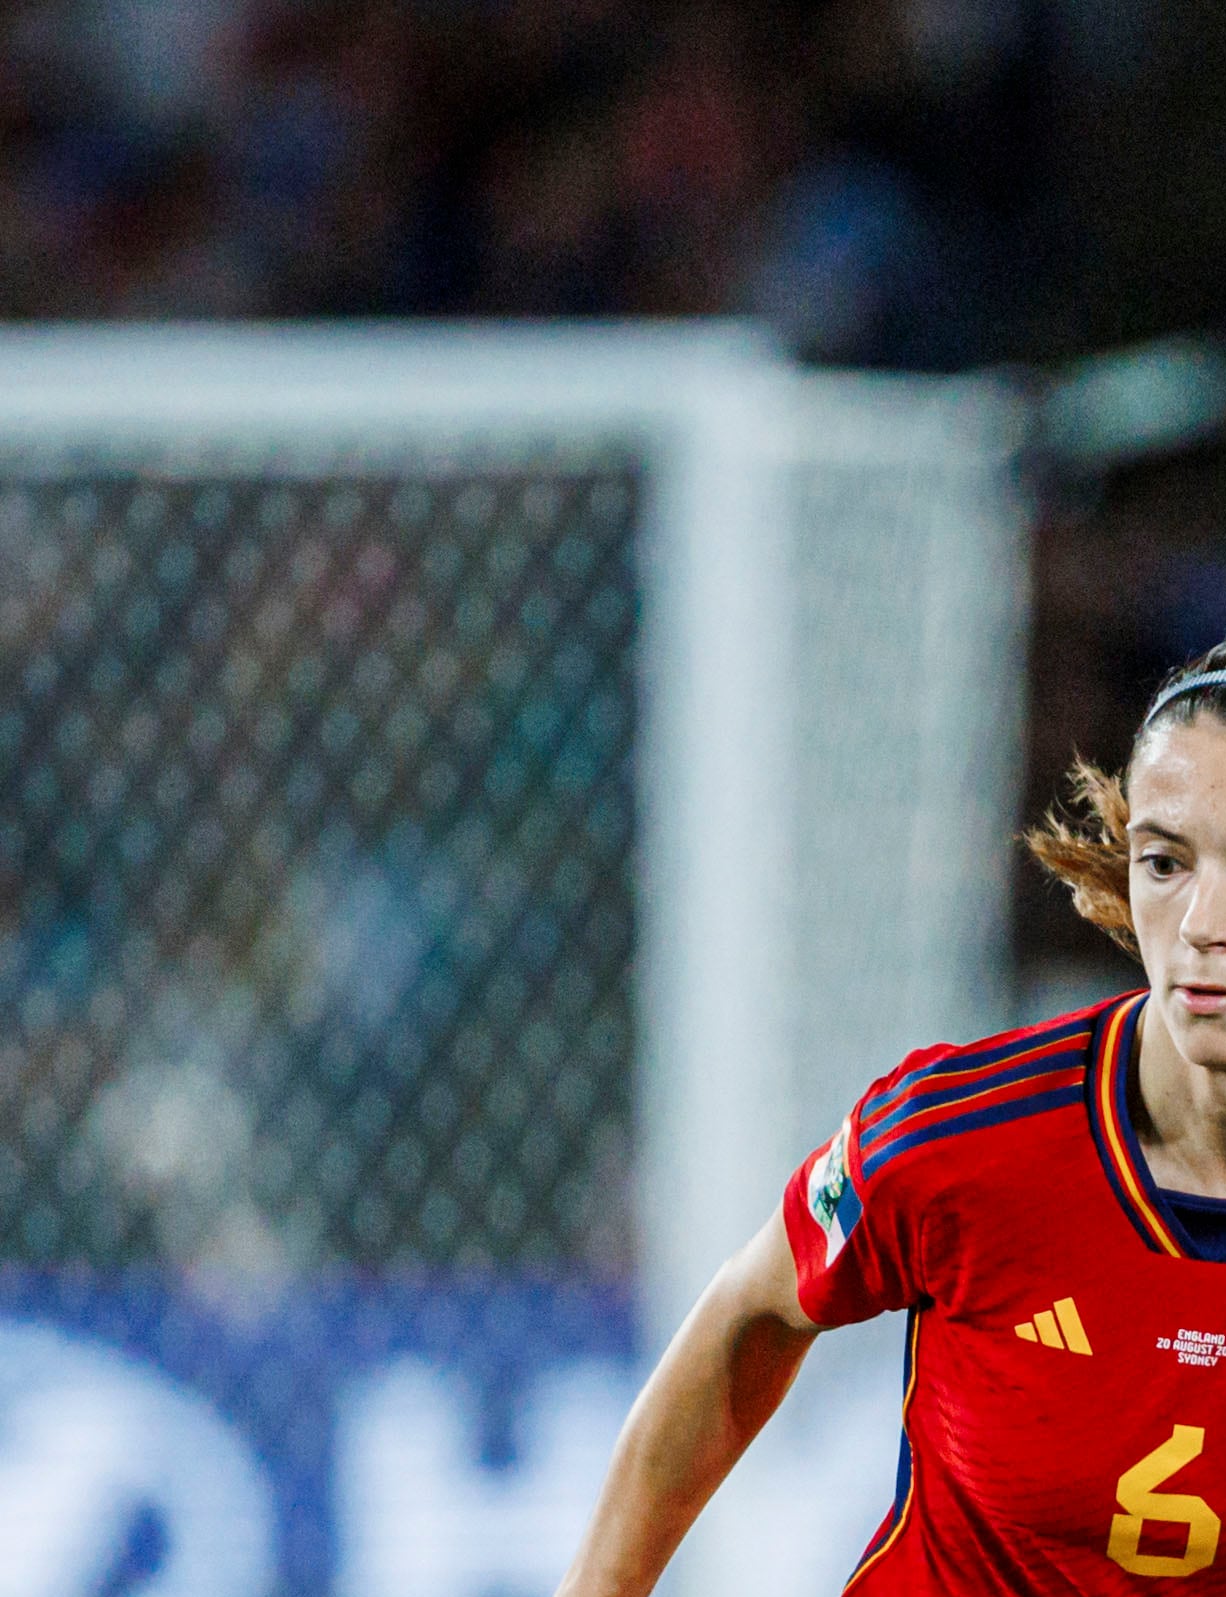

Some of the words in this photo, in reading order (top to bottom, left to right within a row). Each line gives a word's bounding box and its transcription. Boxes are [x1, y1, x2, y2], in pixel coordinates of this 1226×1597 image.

[1156, 1337, 1171, 1350] 20
[1172, 1339, 1214, 1355] AUGUST
[1177, 1328, 1225, 1346] ENGLAND
[1177, 1351, 1219, 1367] SYDNEY
[1106, 1423, 1222, 1578] 6
